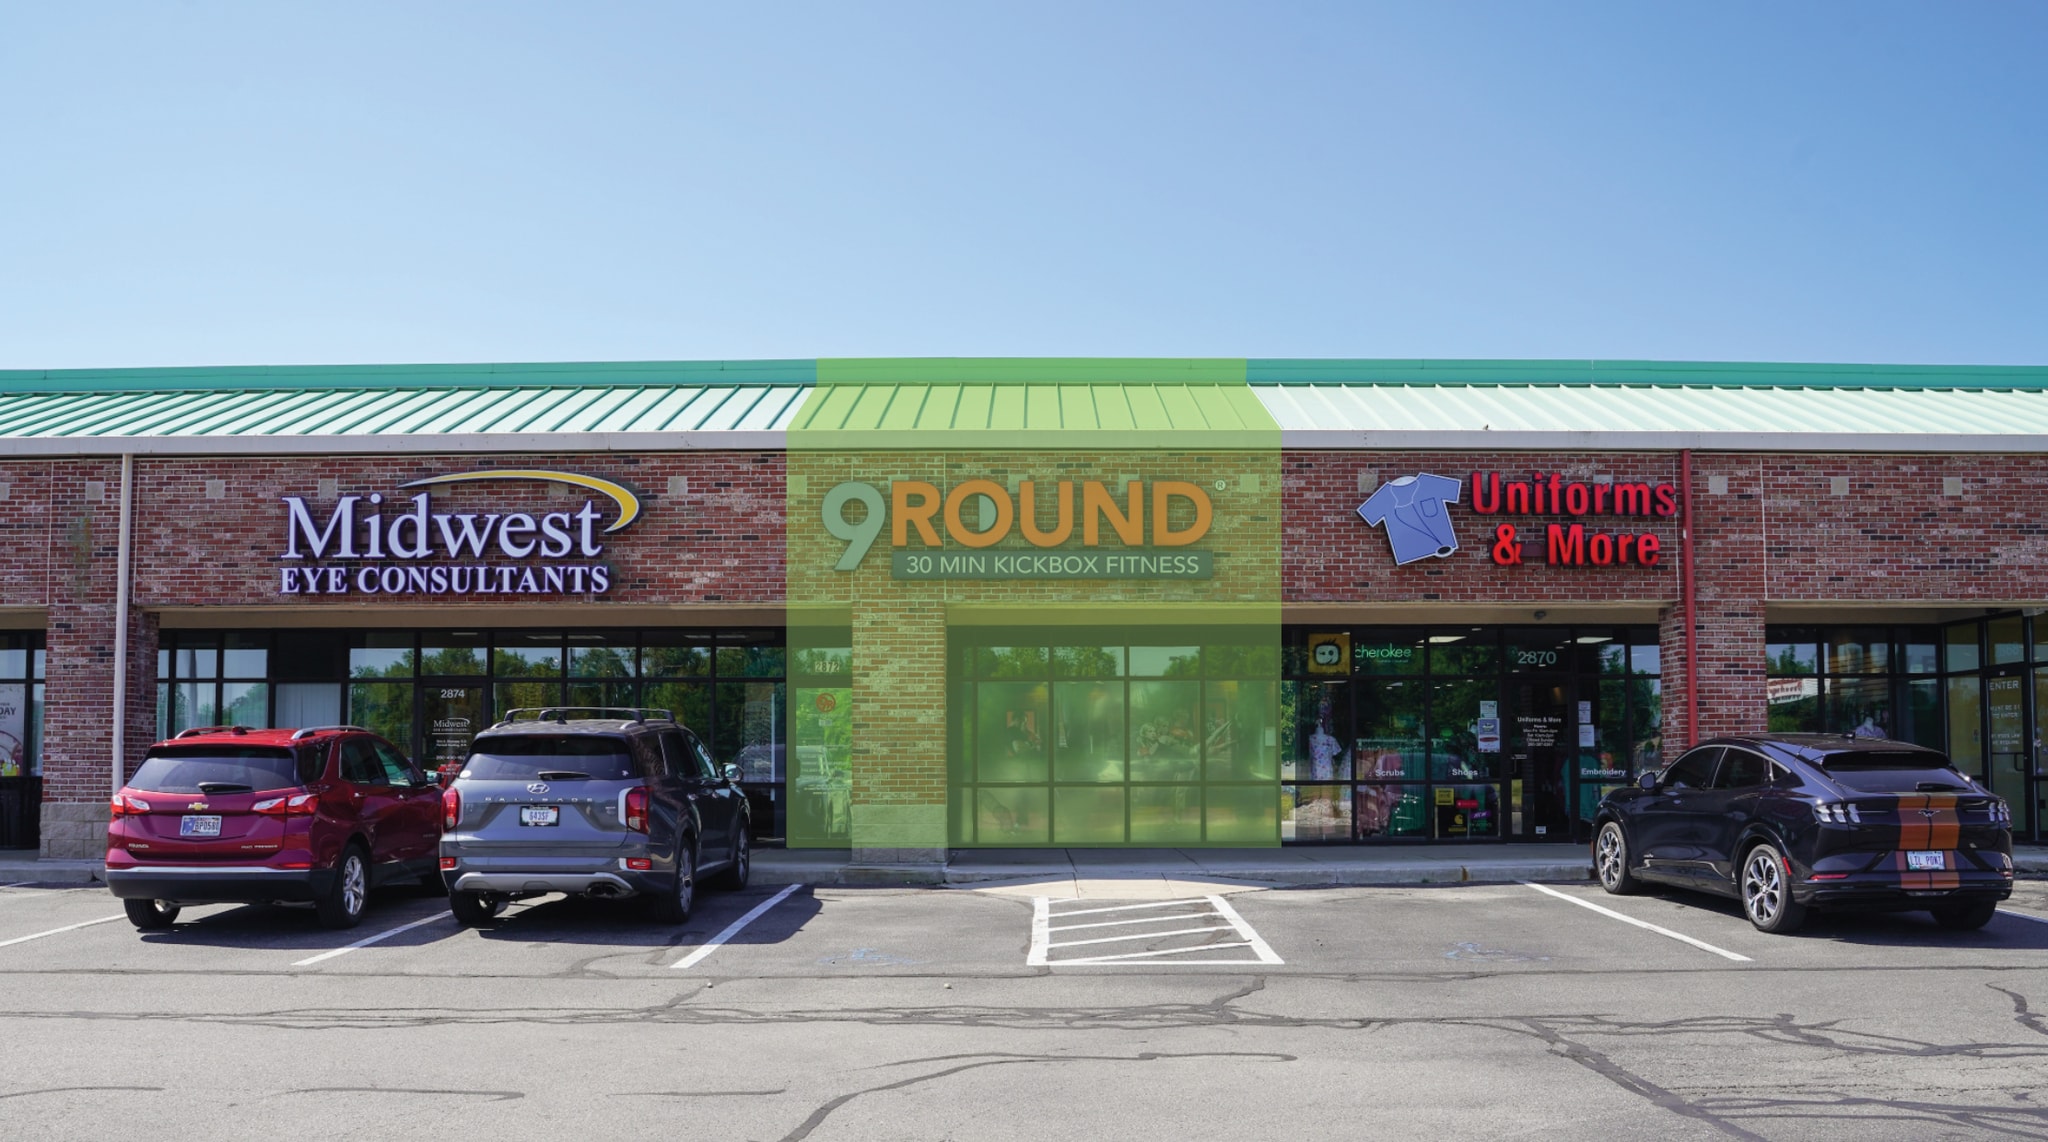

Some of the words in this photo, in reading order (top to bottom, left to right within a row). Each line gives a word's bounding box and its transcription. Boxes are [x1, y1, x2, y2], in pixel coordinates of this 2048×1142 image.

[1471, 471, 1677, 515] Uniforms
[281, 492, 604, 559] Midwest
[1492, 523, 1523, 566] &
[1547, 523, 1661, 566] More
[906, 555, 932, 574] 30
[939, 555, 986, 574] MIN
[994, 555, 1099, 574] KICKBOX
[1105, 555, 1200, 574] FITNESS
[280, 566, 347, 593] EYE
[357, 565, 609, 594] CONSULTANTS
[1354, 642, 1412, 659] cherokee
[1518, 650, 1557, 665] 2870
[815, 662, 840, 672] 2872
[1989, 680, 2019, 690] ENTER
[440, 688, 465, 699] 2874
[433, 719, 467, 728] Midwest
[1375, 769, 1405, 777] Scrubs
[1452, 768, 1478, 777] Shoes
[1581, 767, 1626, 777] Embroidery
